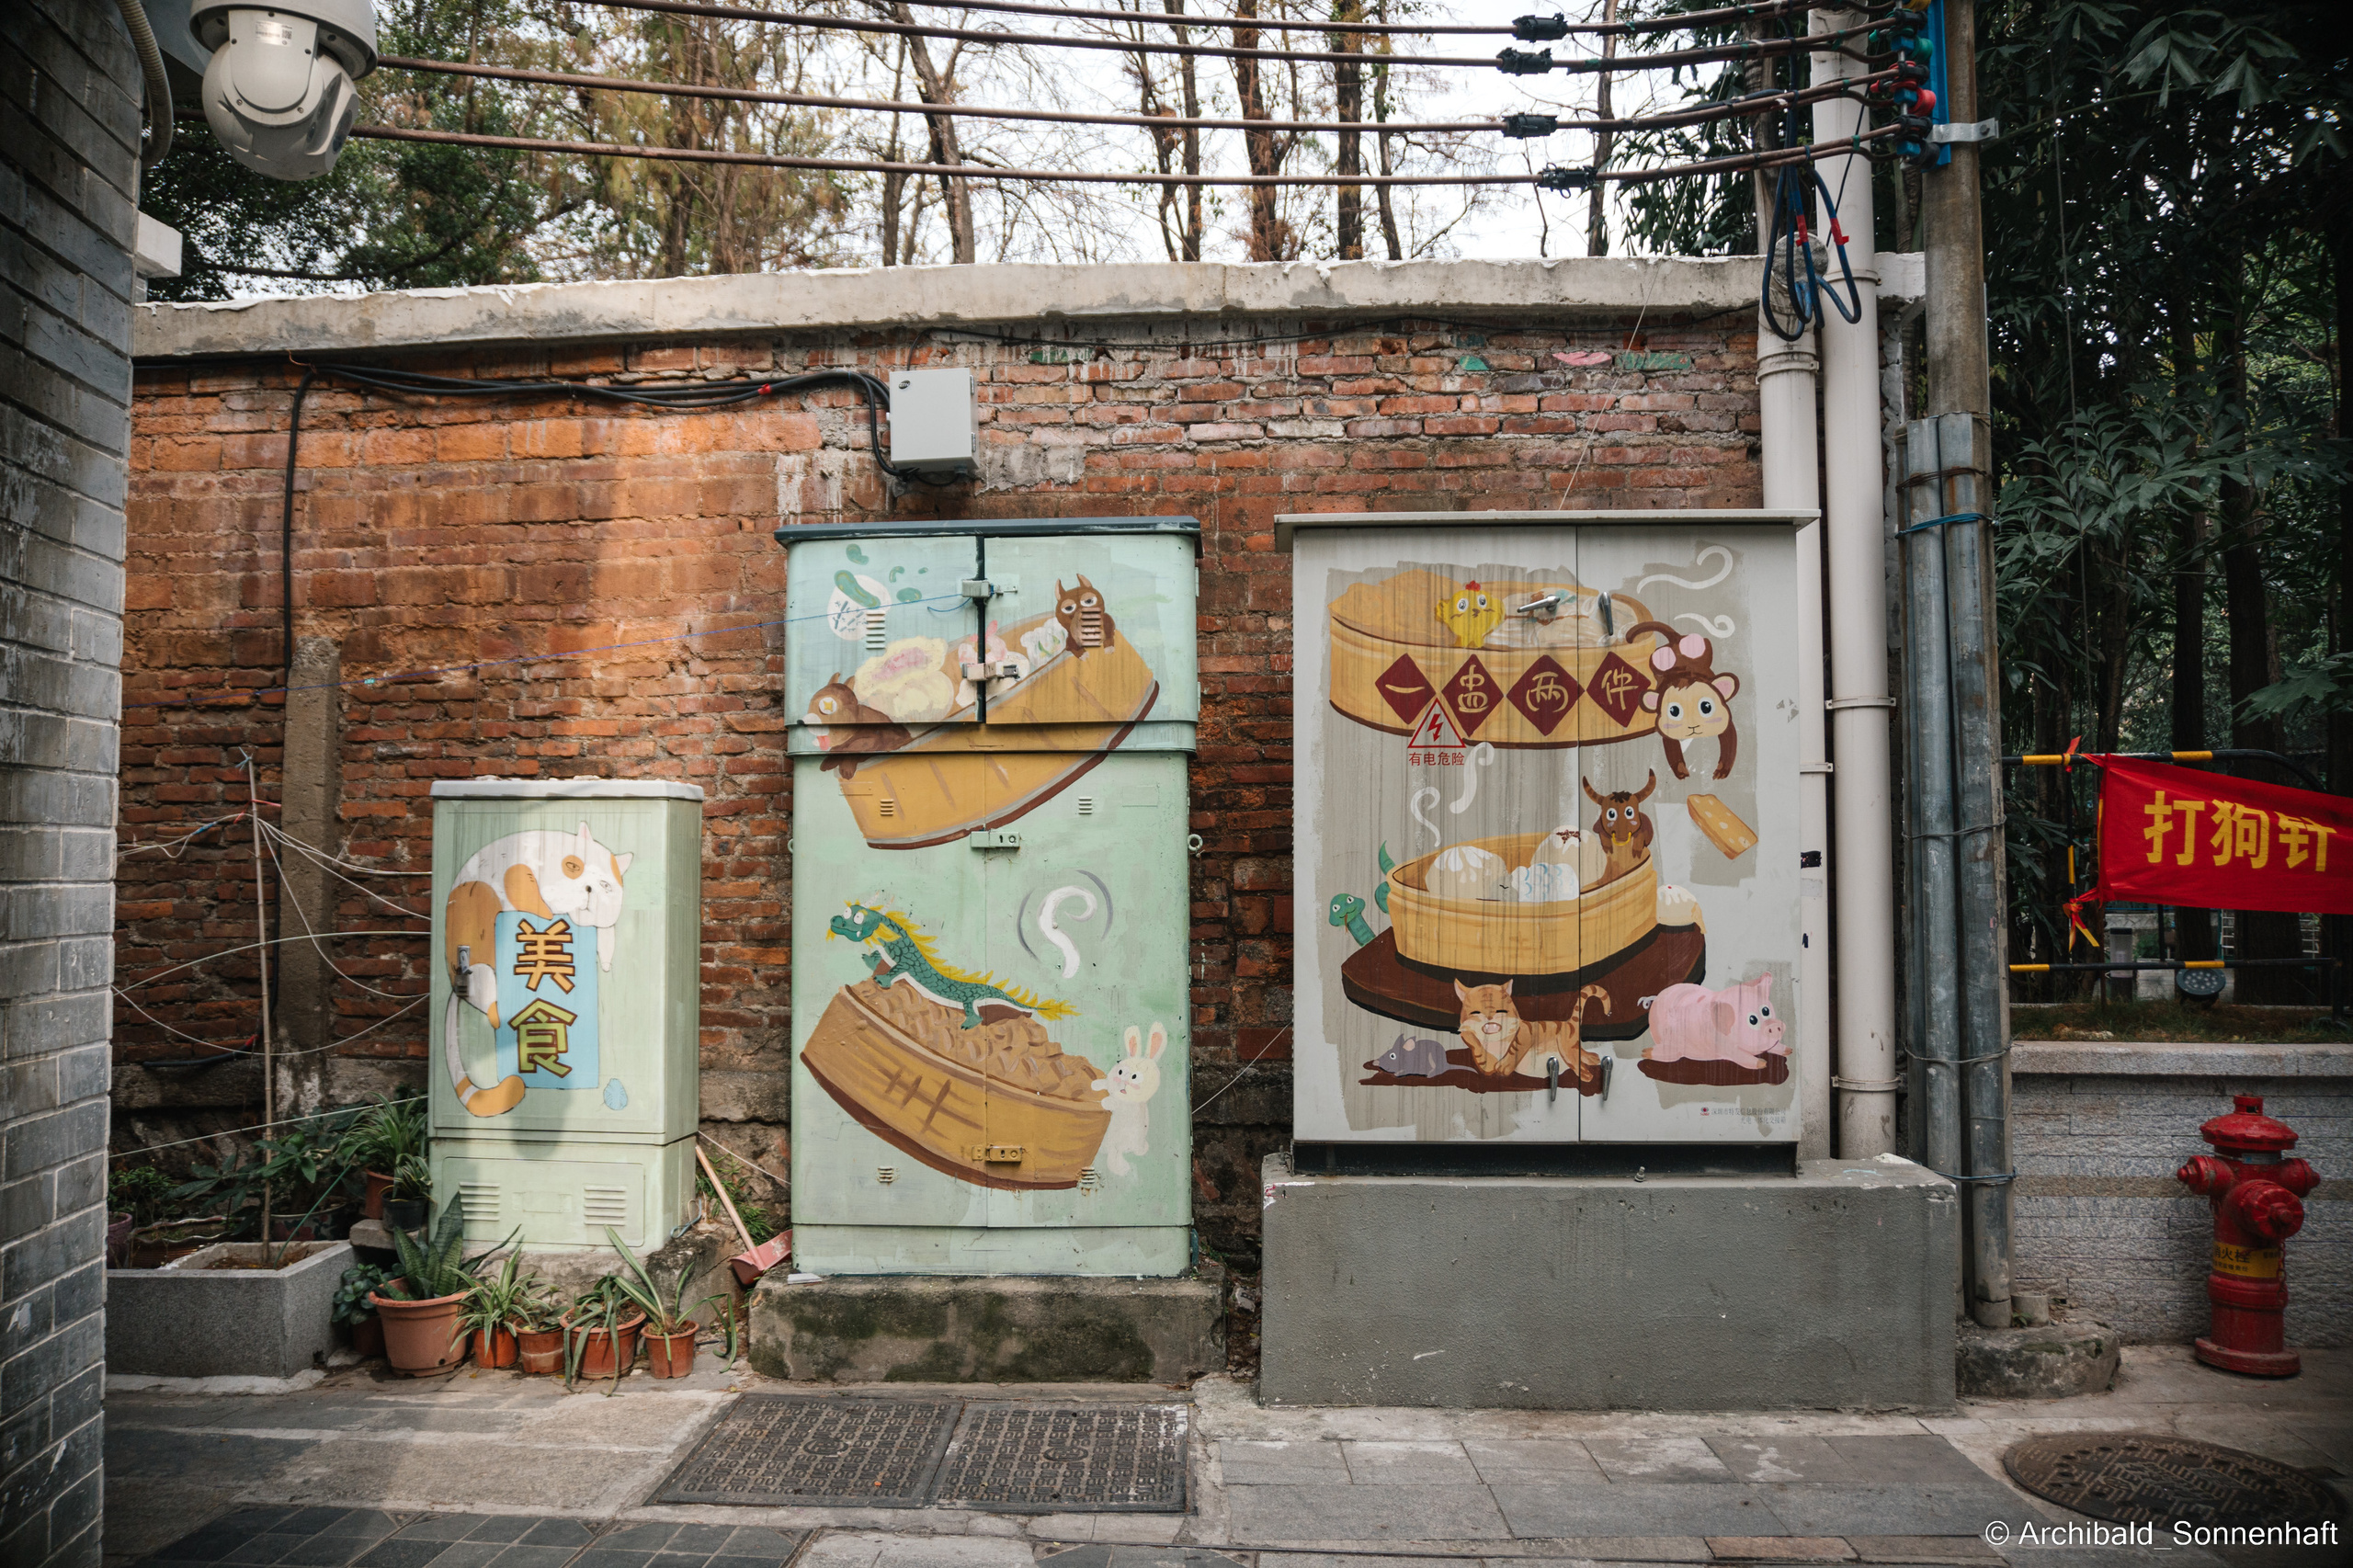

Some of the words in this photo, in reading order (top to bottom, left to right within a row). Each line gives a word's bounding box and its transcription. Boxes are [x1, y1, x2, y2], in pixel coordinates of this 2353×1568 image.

[1385, 664, 1639, 713] 一盅两件
[1408, 751, 1465, 767] 有电危险
[2143, 790, 2337, 872] 打狗针
[508, 917, 577, 1079] 美食
